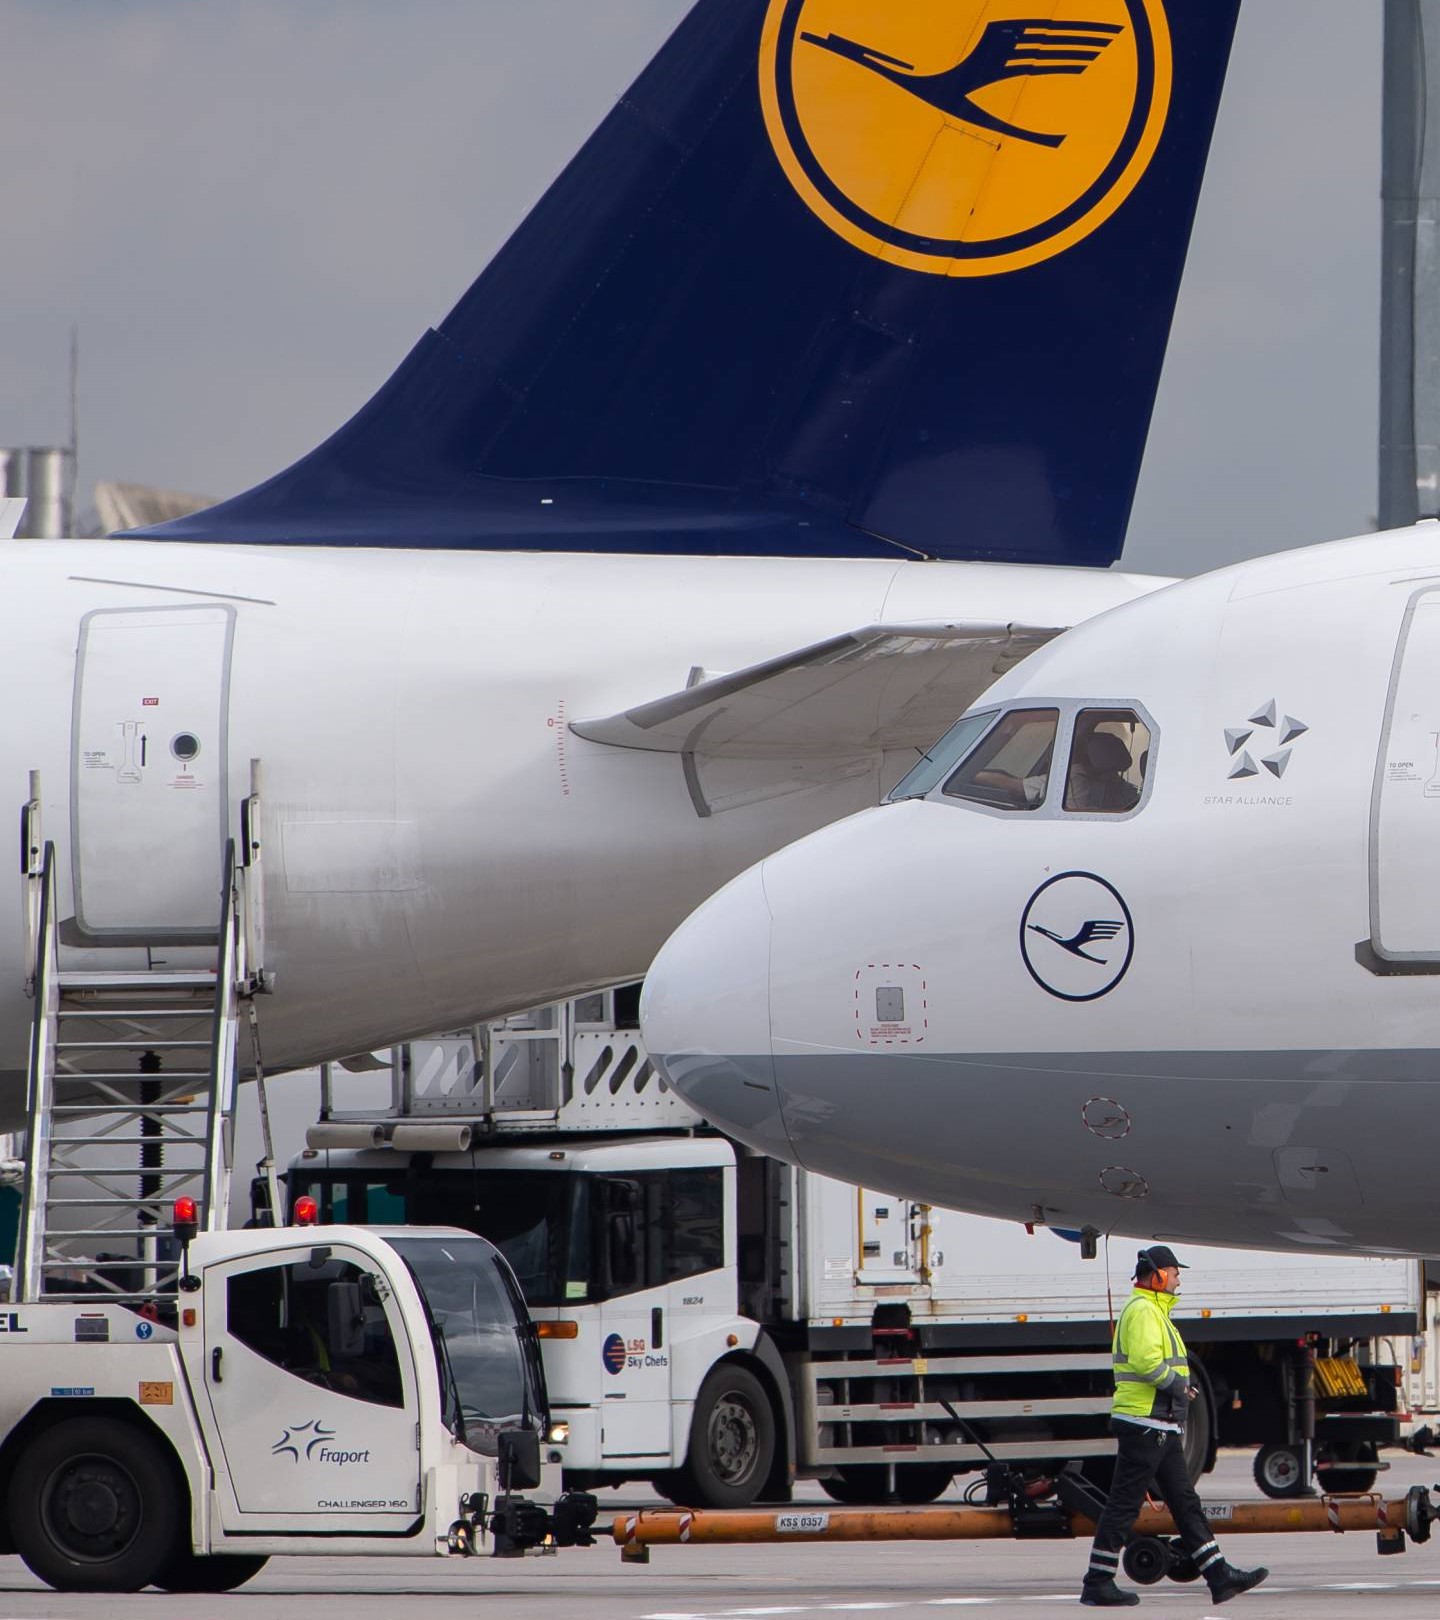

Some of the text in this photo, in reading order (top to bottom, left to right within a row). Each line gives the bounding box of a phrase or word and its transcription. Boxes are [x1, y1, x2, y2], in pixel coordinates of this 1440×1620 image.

[1203, 796, 1293, 805] STAR ALLIANCE
[627, 1339, 645, 1351] LSG
[627, 1355, 668, 1369] Sky Chefs
[319, 1448, 370, 1466] Fraport
[317, 1500, 386, 1508] CHALLENGER
[780, 1517, 823, 1527] KSS 0357
